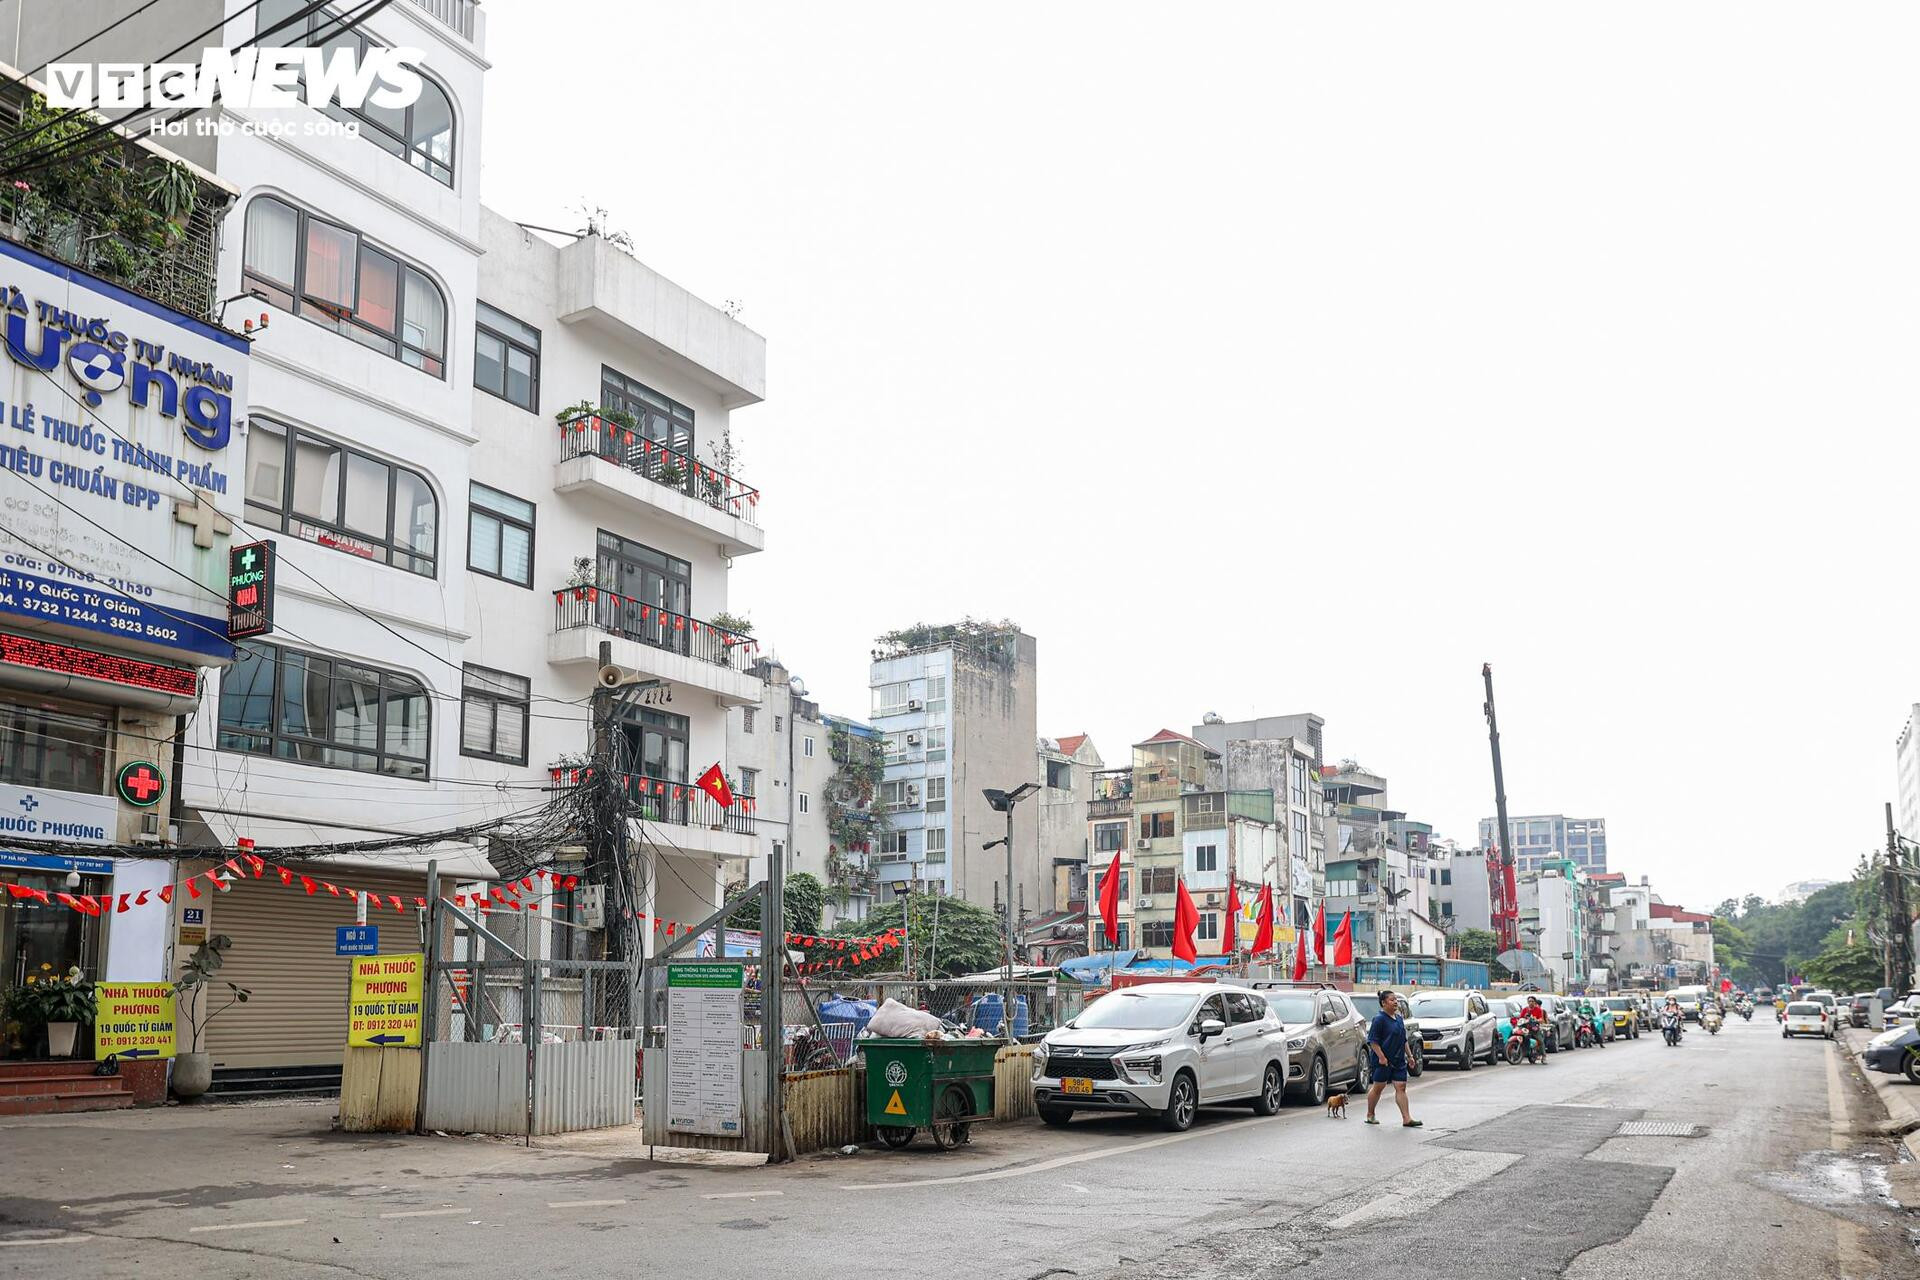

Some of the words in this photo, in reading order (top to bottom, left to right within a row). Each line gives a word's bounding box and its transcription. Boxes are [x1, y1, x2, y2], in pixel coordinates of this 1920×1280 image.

[35, 300, 129, 350] THUỐC
[169, 352, 233, 391] NHÂN
[11, 403, 35, 434] LẺ
[41, 415, 106, 455] THUỐC
[112, 438, 173, 477] THÀNH
[0, 444, 43, 477] TIÊU
[50, 460, 117, 500] CHUẨN
[122, 482, 160, 510] GPP
[4, 553, 42, 570] cửa:
[47, 562, 95, 583] 07h30
[108, 577, 153, 597] 21h30
[231, 569, 264, 586] PHƯỢNG
[17, 578, 35, 592] 19
[39, 583, 80, 602] Quốc
[83, 592, 101, 607] Tử
[103, 598, 141, 617] Giám
[236, 584, 257, 606] NHÀ
[23, 597, 60, 616] 3732
[64, 606, 98, 623] 1244
[110, 617, 142, 634] 3823
[146, 625, 178, 641] 5602
[232, 605, 262, 631] THUỐC
[42, 821, 104, 840] PHƯỢNG
[187, 910, 200, 919] 21
[359, 961, 380, 975] NHÀ
[384, 957, 416, 974] THUỐC
[104, 987, 129, 999] NHÀ
[132, 985, 168, 998] THUỐC
[366, 981, 407, 996] PHƯỢNG
[114, 1004, 160, 1017] PHƯỢNG
[354, 1005, 363, 1016] 19
[365, 1001, 384, 1016] QUỐC
[387, 1001, 396, 1015] TỬ
[398, 1002, 419, 1014] GIÁM
[100, 1024, 112, 1033] 19
[113, 1021, 136, 1033] QUỐC
[139, 1020, 149, 1032] TỬ
[151, 1021, 173, 1032] GIÁM
[353, 1021, 364, 1031] ĐT:
[367, 1020, 385, 1030] 0912
[387, 1019, 401, 1029] 320
[403, 1019, 417, 1029] 441
[101, 1038, 113, 1046] ĐT:
[116, 1037, 138, 1046] 0912
[140, 1037, 155, 1045] 320
[157, 1036, 172, 1044] 441
